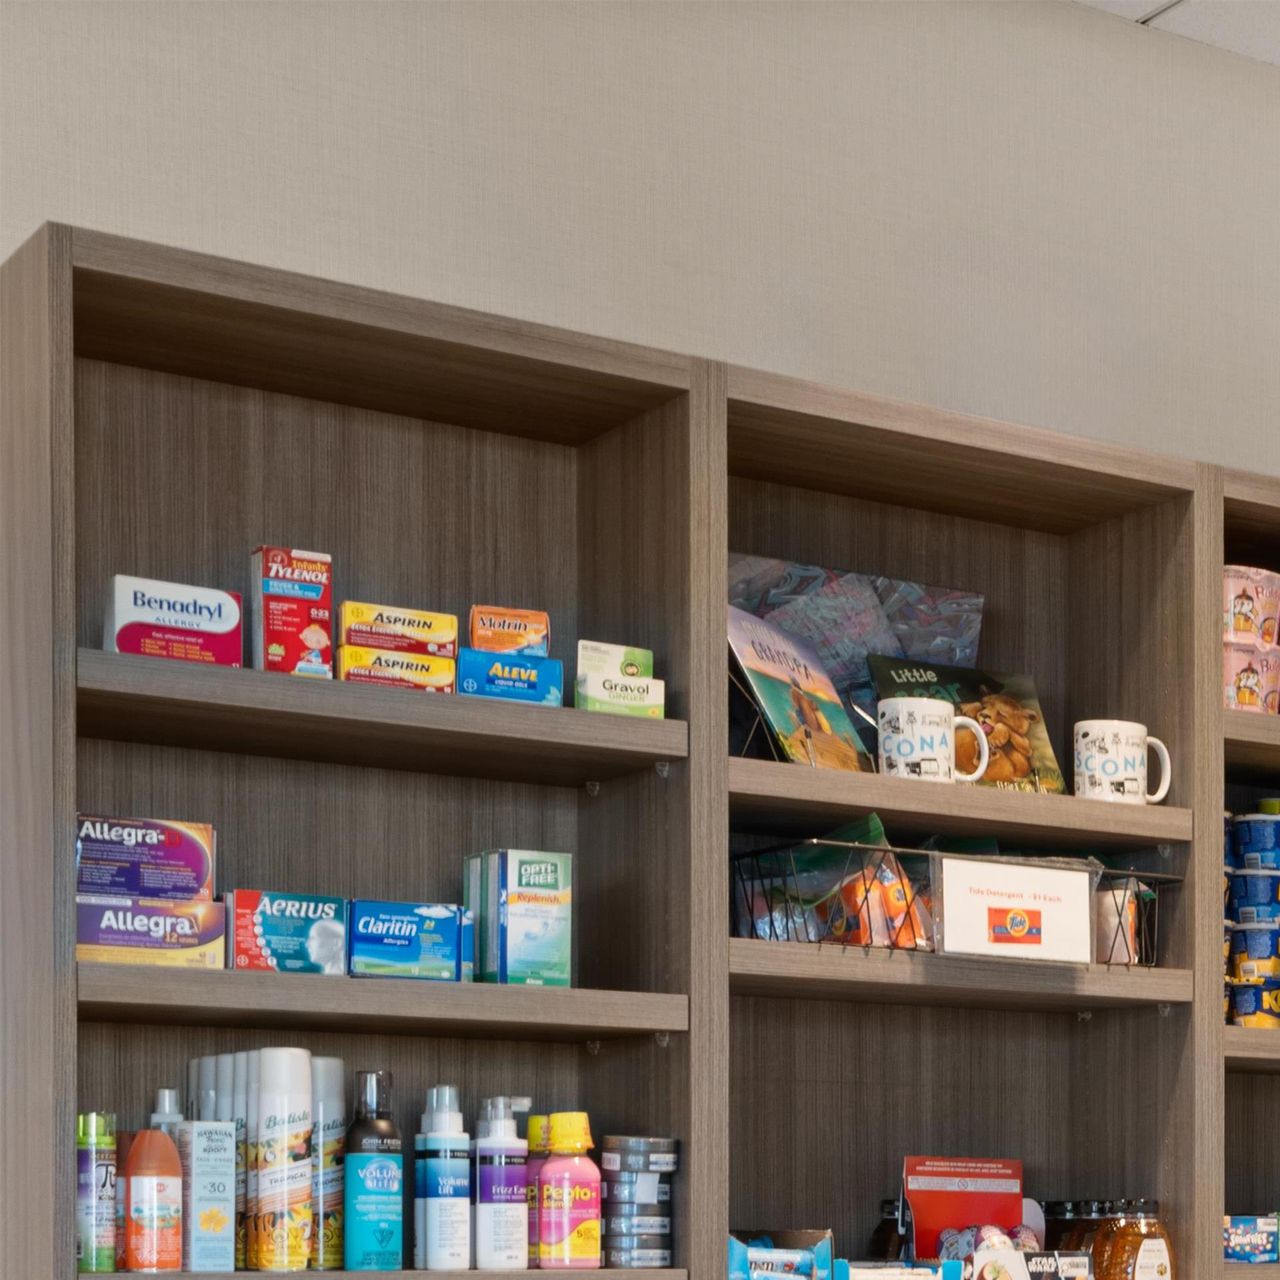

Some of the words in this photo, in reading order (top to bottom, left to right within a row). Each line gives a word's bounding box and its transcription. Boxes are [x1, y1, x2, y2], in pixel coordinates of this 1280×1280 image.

[269, 563, 328, 584] TYLENOL
[133, 590, 224, 620] Benadryl
[155, 616, 201, 629] ALLERGY
[374, 611, 433, 630] ASPIRIN
[478, 616, 528, 633] Motrin
[372, 656, 430, 673] ASPIRIN
[489, 662, 538, 681] ALEVE
[890, 668, 938, 684] Little
[603, 679, 650, 696] Gravol
[101, 910, 193, 939] Allegra
[358, 916, 417, 937] Claritin
